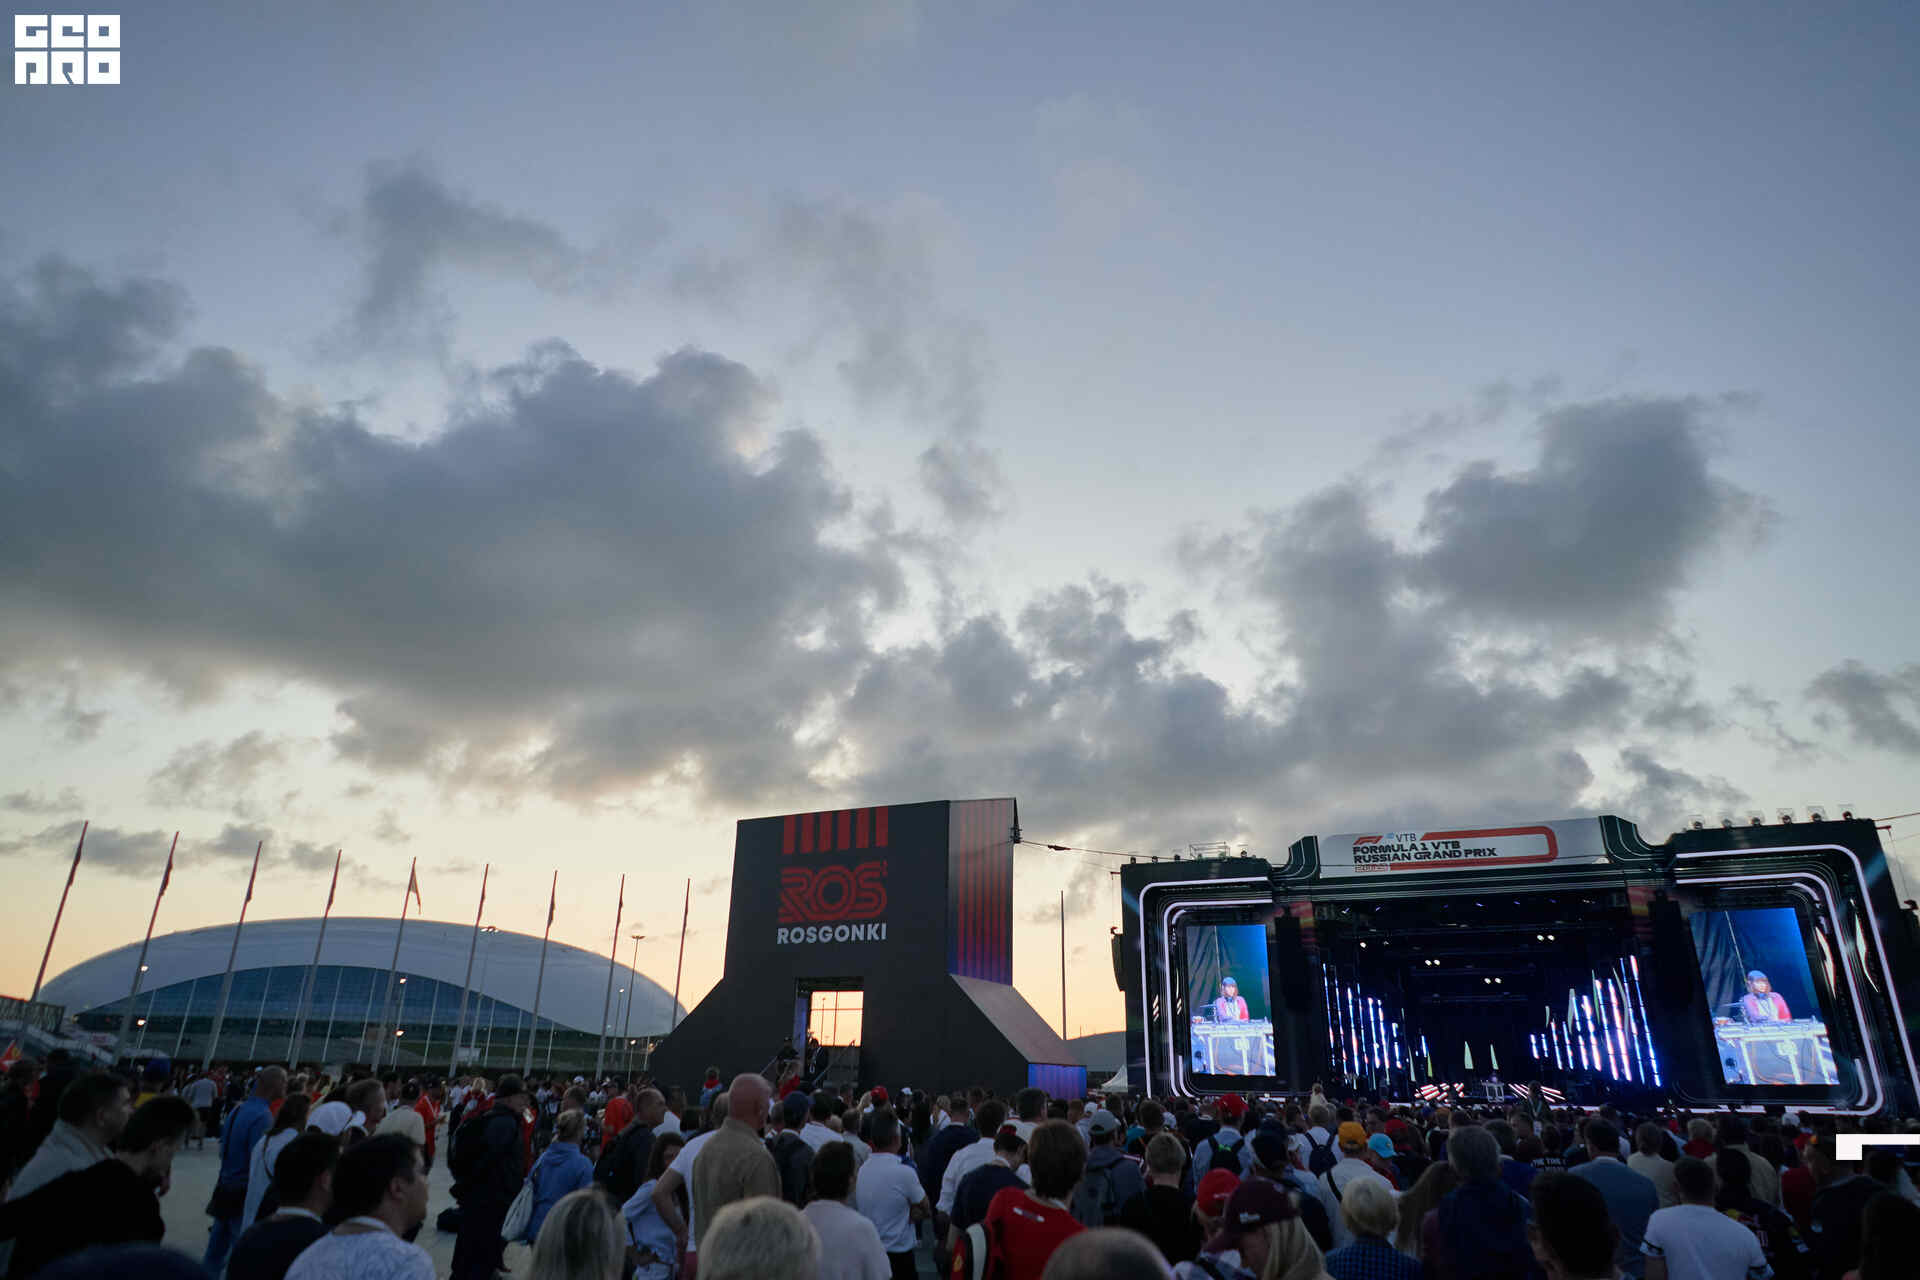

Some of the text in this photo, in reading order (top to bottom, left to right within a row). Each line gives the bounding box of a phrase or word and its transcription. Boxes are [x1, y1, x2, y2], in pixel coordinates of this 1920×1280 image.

[1395, 832, 1417, 842] VTB
[1352, 840, 1461, 855] FORMULA 1 VTB
[1354, 847, 1498, 864] RUSSIAN GRAND PRIX
[777, 923, 887, 944] ROSGONKI
